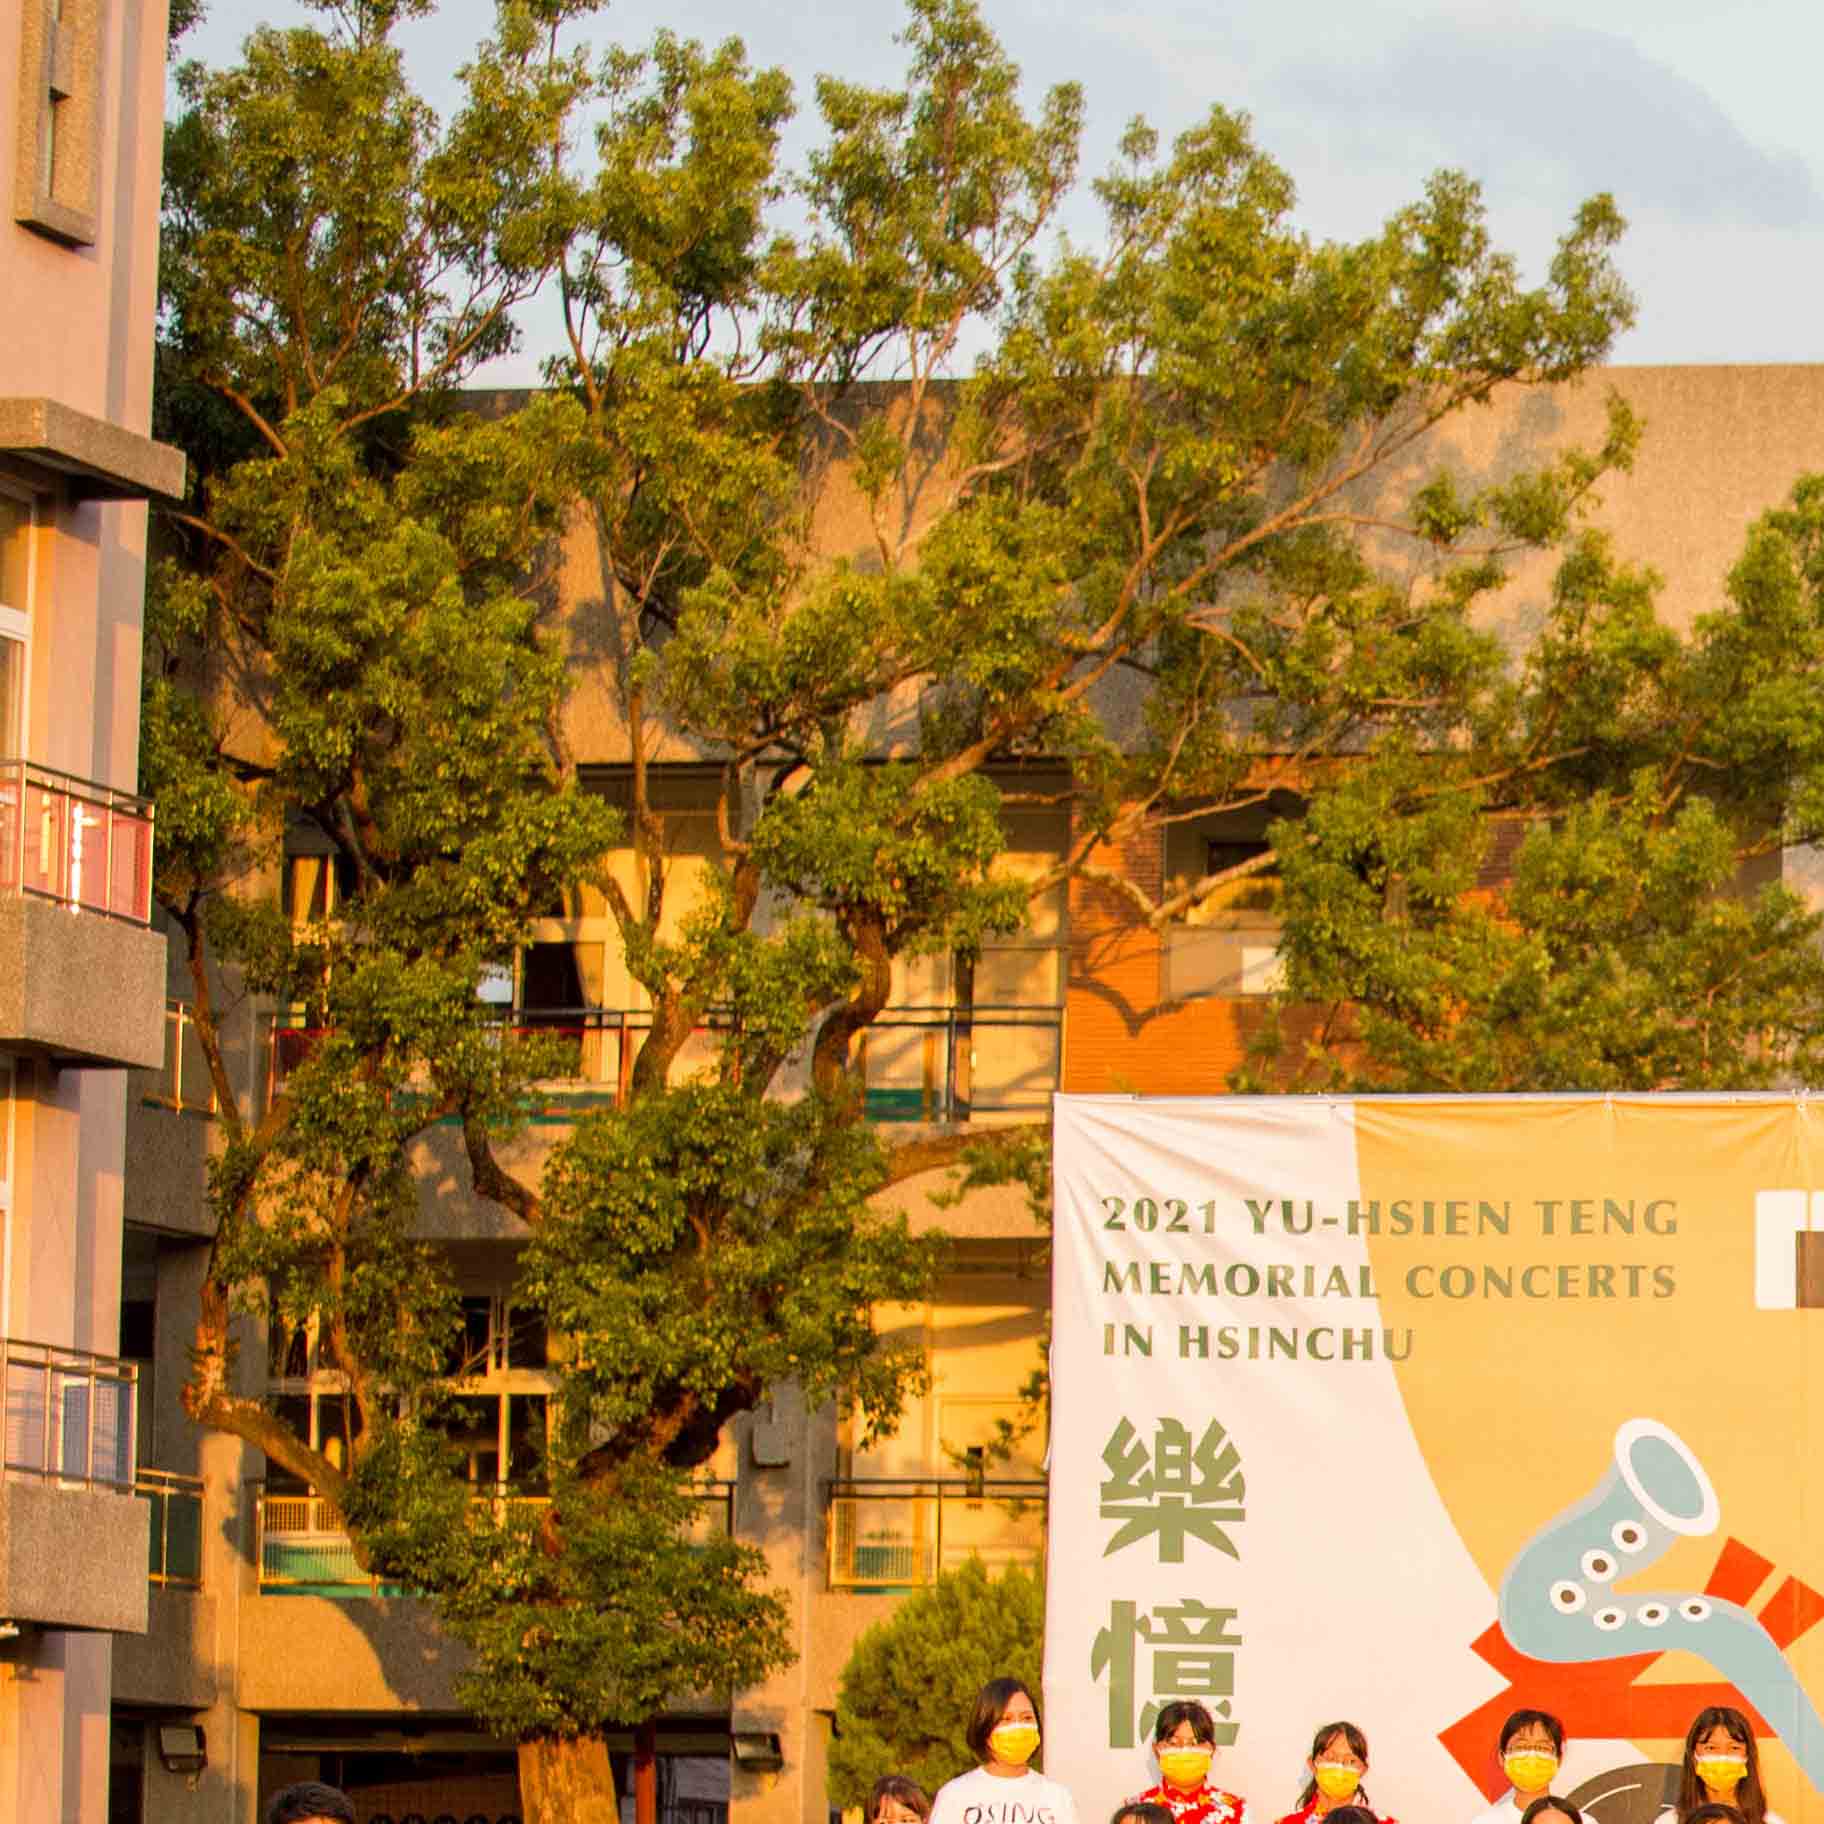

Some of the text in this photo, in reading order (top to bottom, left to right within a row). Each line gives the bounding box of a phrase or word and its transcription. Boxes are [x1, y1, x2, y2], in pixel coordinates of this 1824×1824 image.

[1101, 1196, 1678, 1236] 2021 YU-HSIEN TENG
[1102, 1260, 1677, 1299] MEMORIAL CONCERTS
[1103, 1323, 1415, 1361] IN HSINCHU
